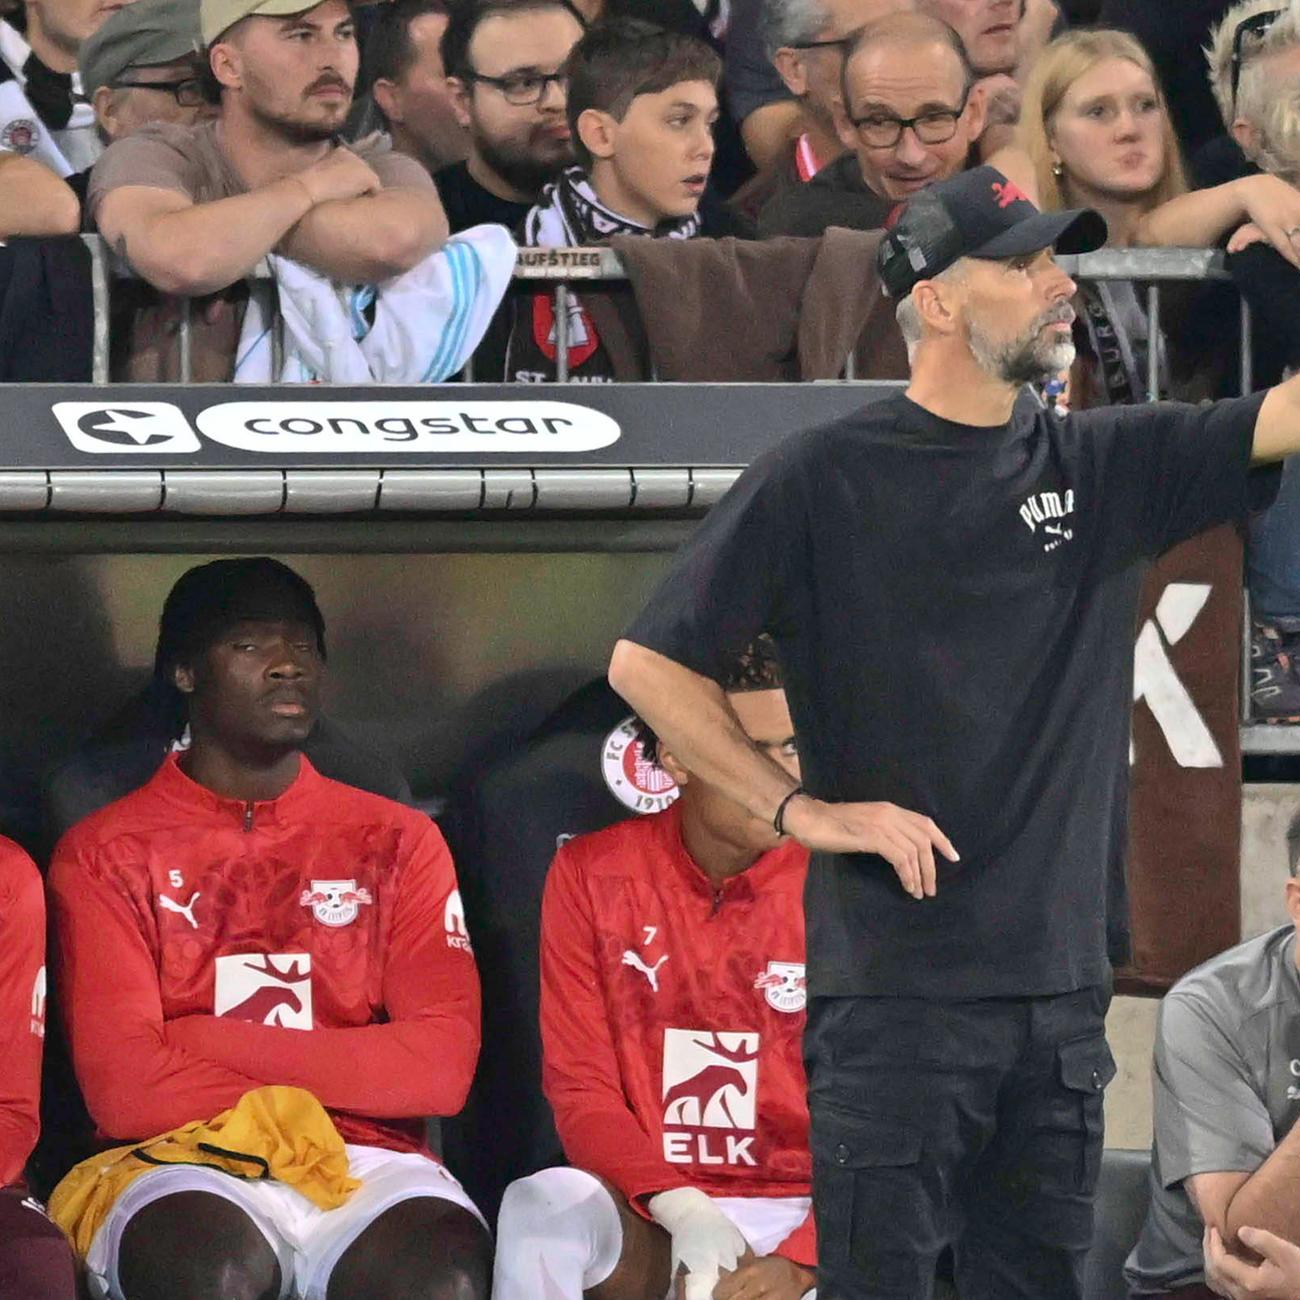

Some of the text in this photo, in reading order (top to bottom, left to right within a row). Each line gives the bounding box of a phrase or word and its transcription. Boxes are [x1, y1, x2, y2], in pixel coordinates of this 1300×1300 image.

[243, 412, 573, 442] congstar
[606, 740, 623, 761] FC
[168, 869, 184, 888] 5
[642, 926, 658, 945] 7
[662, 1132, 759, 1166] ELK
